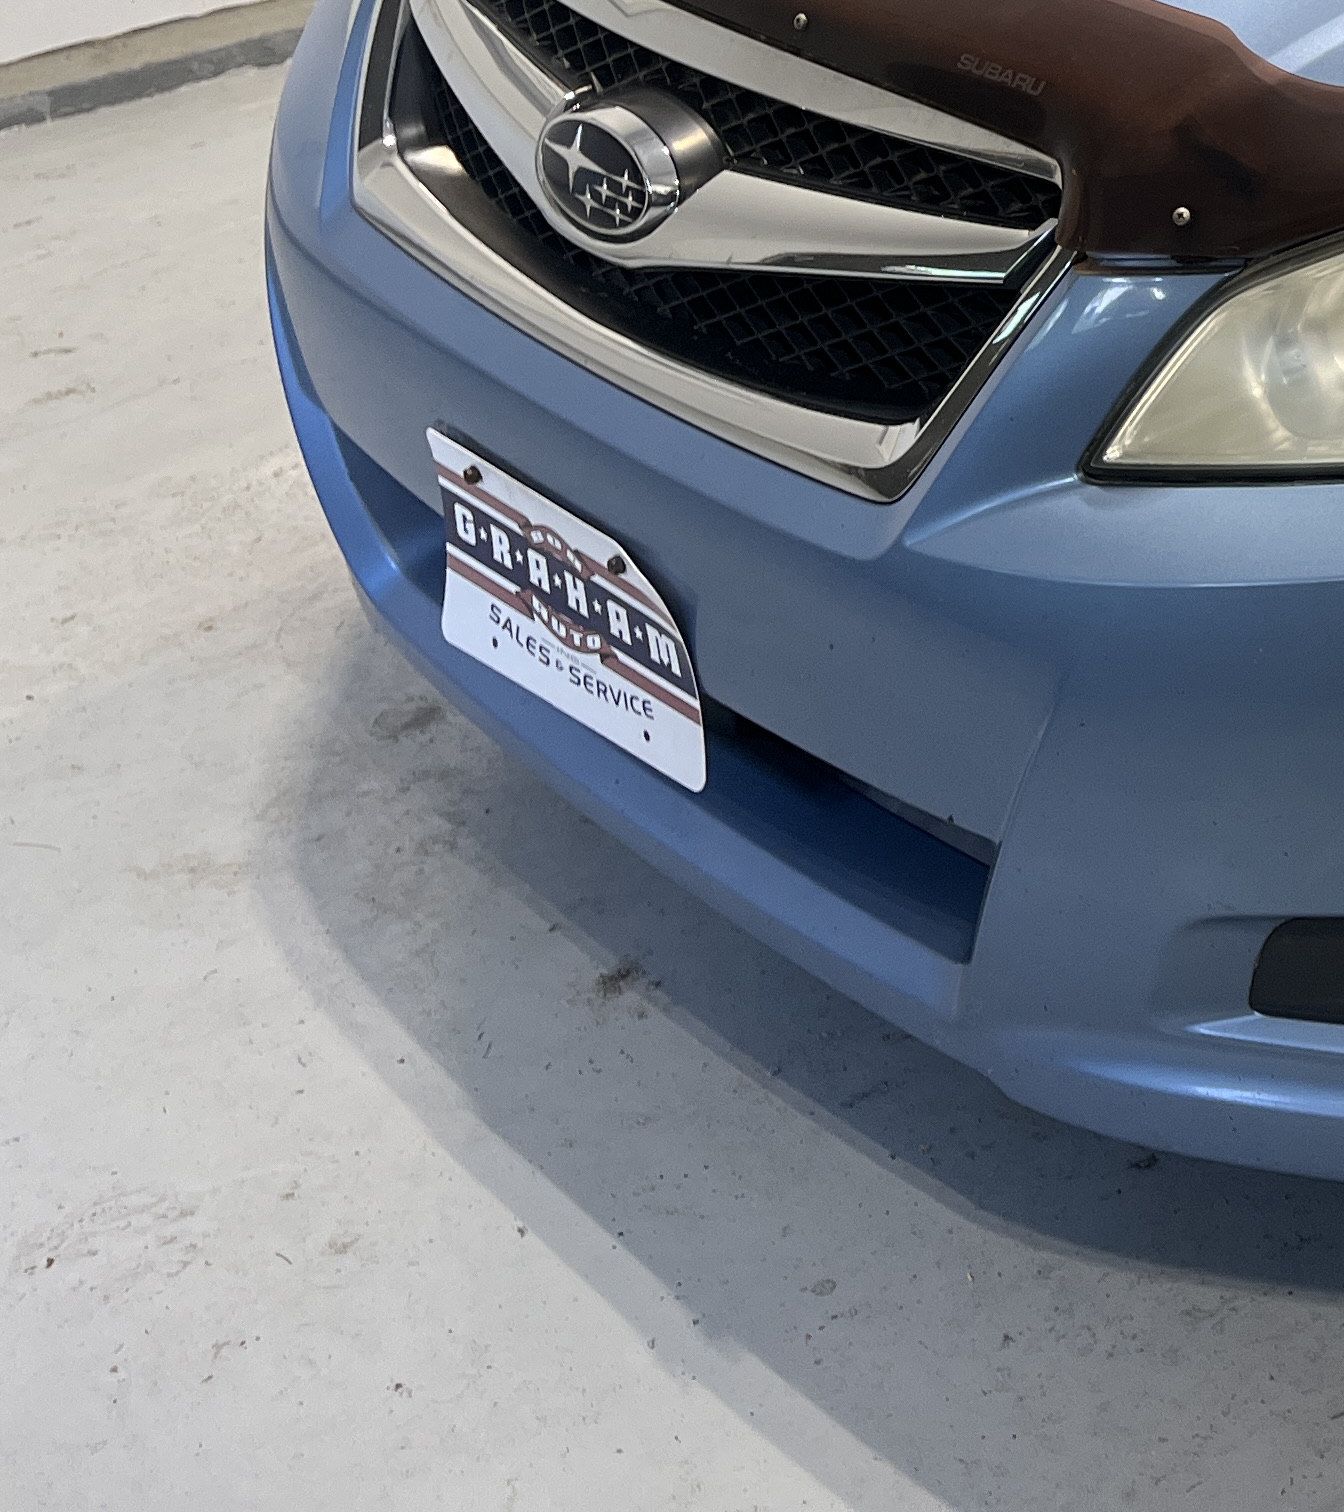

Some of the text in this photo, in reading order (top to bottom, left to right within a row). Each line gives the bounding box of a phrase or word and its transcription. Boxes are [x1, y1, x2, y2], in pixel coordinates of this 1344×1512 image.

[957, 53, 1047, 96] SUBARU
[453, 501, 683, 678] GRAHAM
[532, 594, 602, 650] AUTO
[489, 603, 551, 668] SALES
[569, 665, 655, 720] SERVICE
